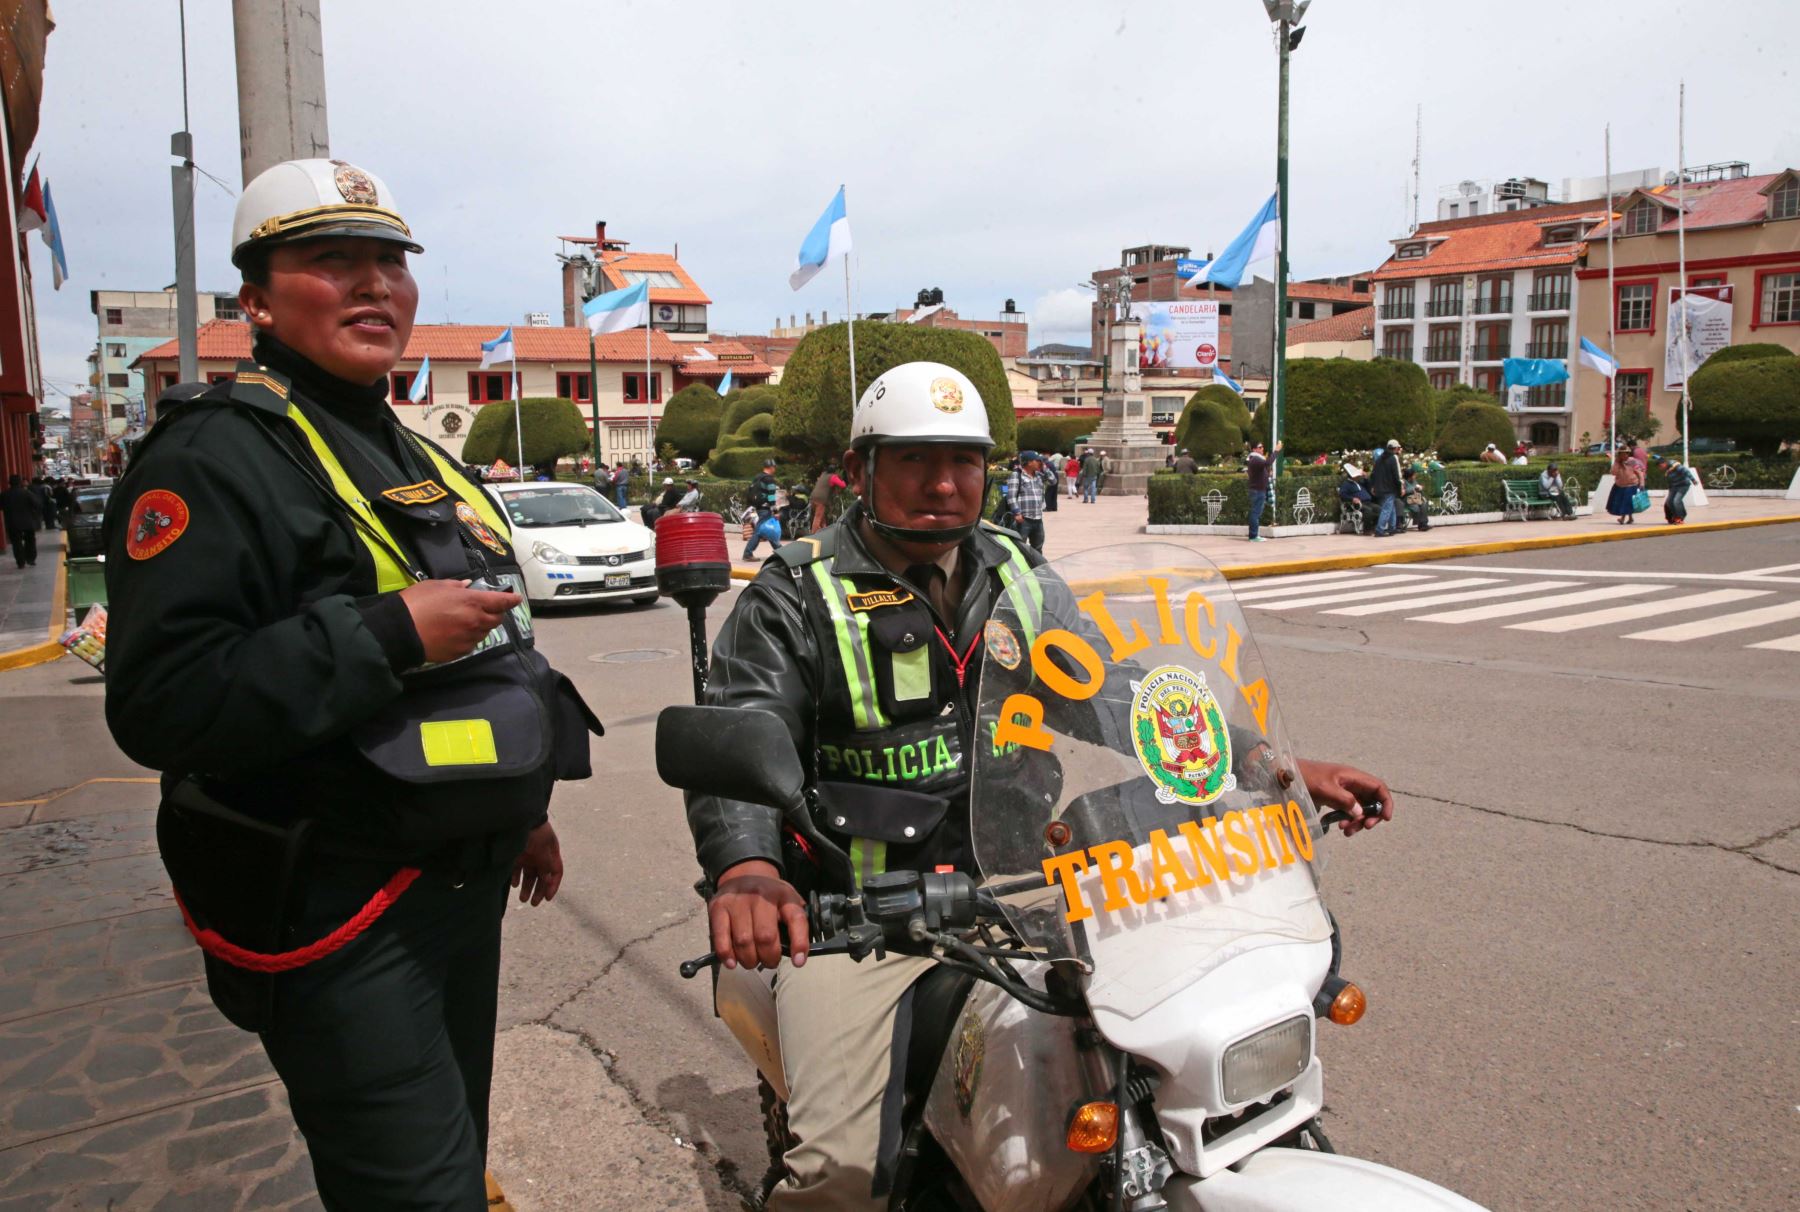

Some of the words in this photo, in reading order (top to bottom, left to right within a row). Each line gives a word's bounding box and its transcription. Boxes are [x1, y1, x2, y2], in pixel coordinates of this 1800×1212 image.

[1168, 304, 1217, 314] CANDELARIA
[1197, 350, 1213, 358] Claro
[134, 527, 181, 558] TRANSITO
[861, 593, 898, 606] VILLALTA
[994, 576, 1270, 752] POLICIA
[1140, 676, 1165, 709] POLICIA
[1166, 672, 1207, 698] NACIONAL
[1160, 687, 1172, 698] DEL
[1172, 685, 1189, 694] PERU
[821, 735, 957, 781] POLICIA
[1042, 800, 1313, 923] TRANSITO
